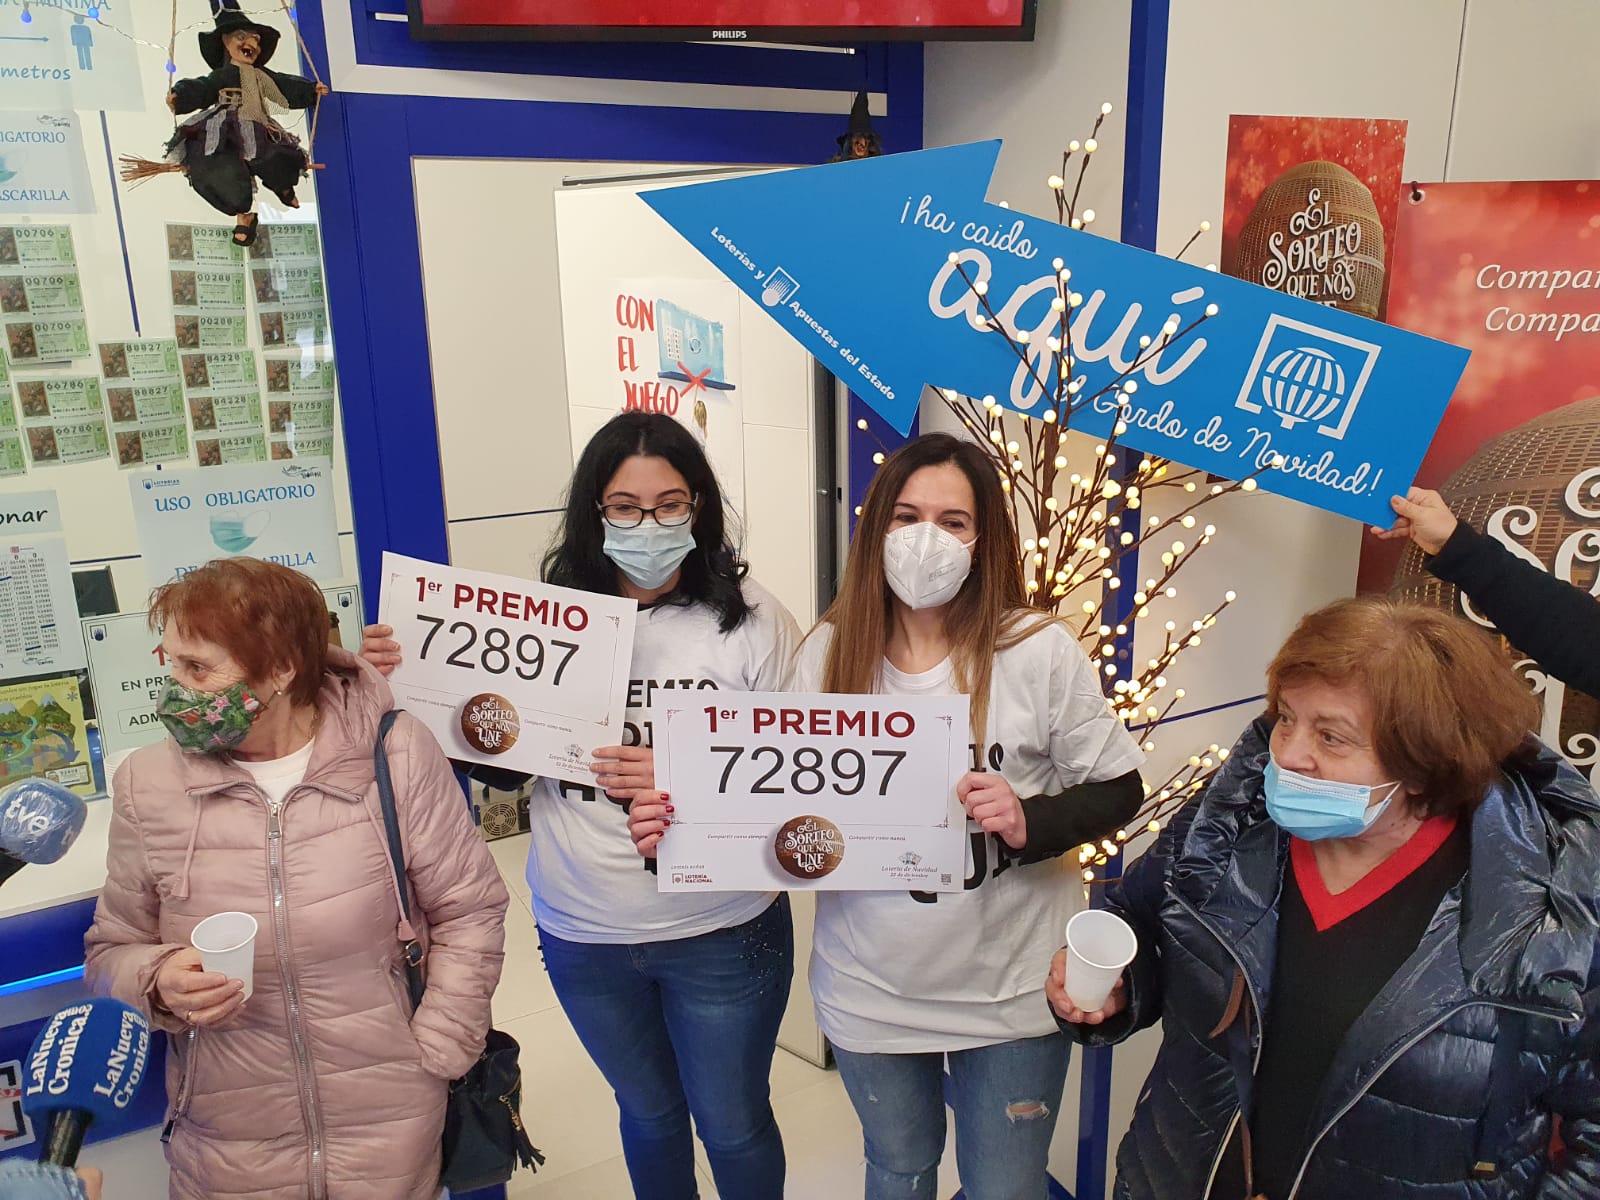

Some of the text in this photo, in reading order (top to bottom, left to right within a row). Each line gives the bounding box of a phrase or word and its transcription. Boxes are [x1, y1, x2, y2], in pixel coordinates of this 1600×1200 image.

[712, 30, 747, 39] PHILIPS
[0, 65, 71, 80] metros
[0, 189, 70, 201] SCARILLA
[1290, 188, 1333, 236] EL
[1262, 222, 1362, 290] SORTEO
[1287, 259, 1356, 300] QUE NOS
[616, 294, 655, 332] CON
[711, 226, 896, 400] Loterías y Apuestas del Estado
[928, 248, 1207, 409] aquí
[618, 336, 640, 372] EL
[621, 380, 679, 416] JUEGO
[1193, 416, 1232, 452] de
[1239, 427, 1383, 497] Navidad!
[155, 484, 315, 512] USO OBLIGATORIO
[454, 583, 588, 632] PREMIO
[416, 614, 579, 687] 72897
[121, 680, 141, 691] EN
[470, 705, 513, 723] SORTEO
[753, 708, 915, 738] PREMIO
[710, 746, 907, 796] 72897
[785, 829, 835, 849] SORTEO
[793, 853, 825, 873] UNE
[26, 1011, 67, 1097] LaNueva
[93, 1010, 135, 1098] LaNueva
